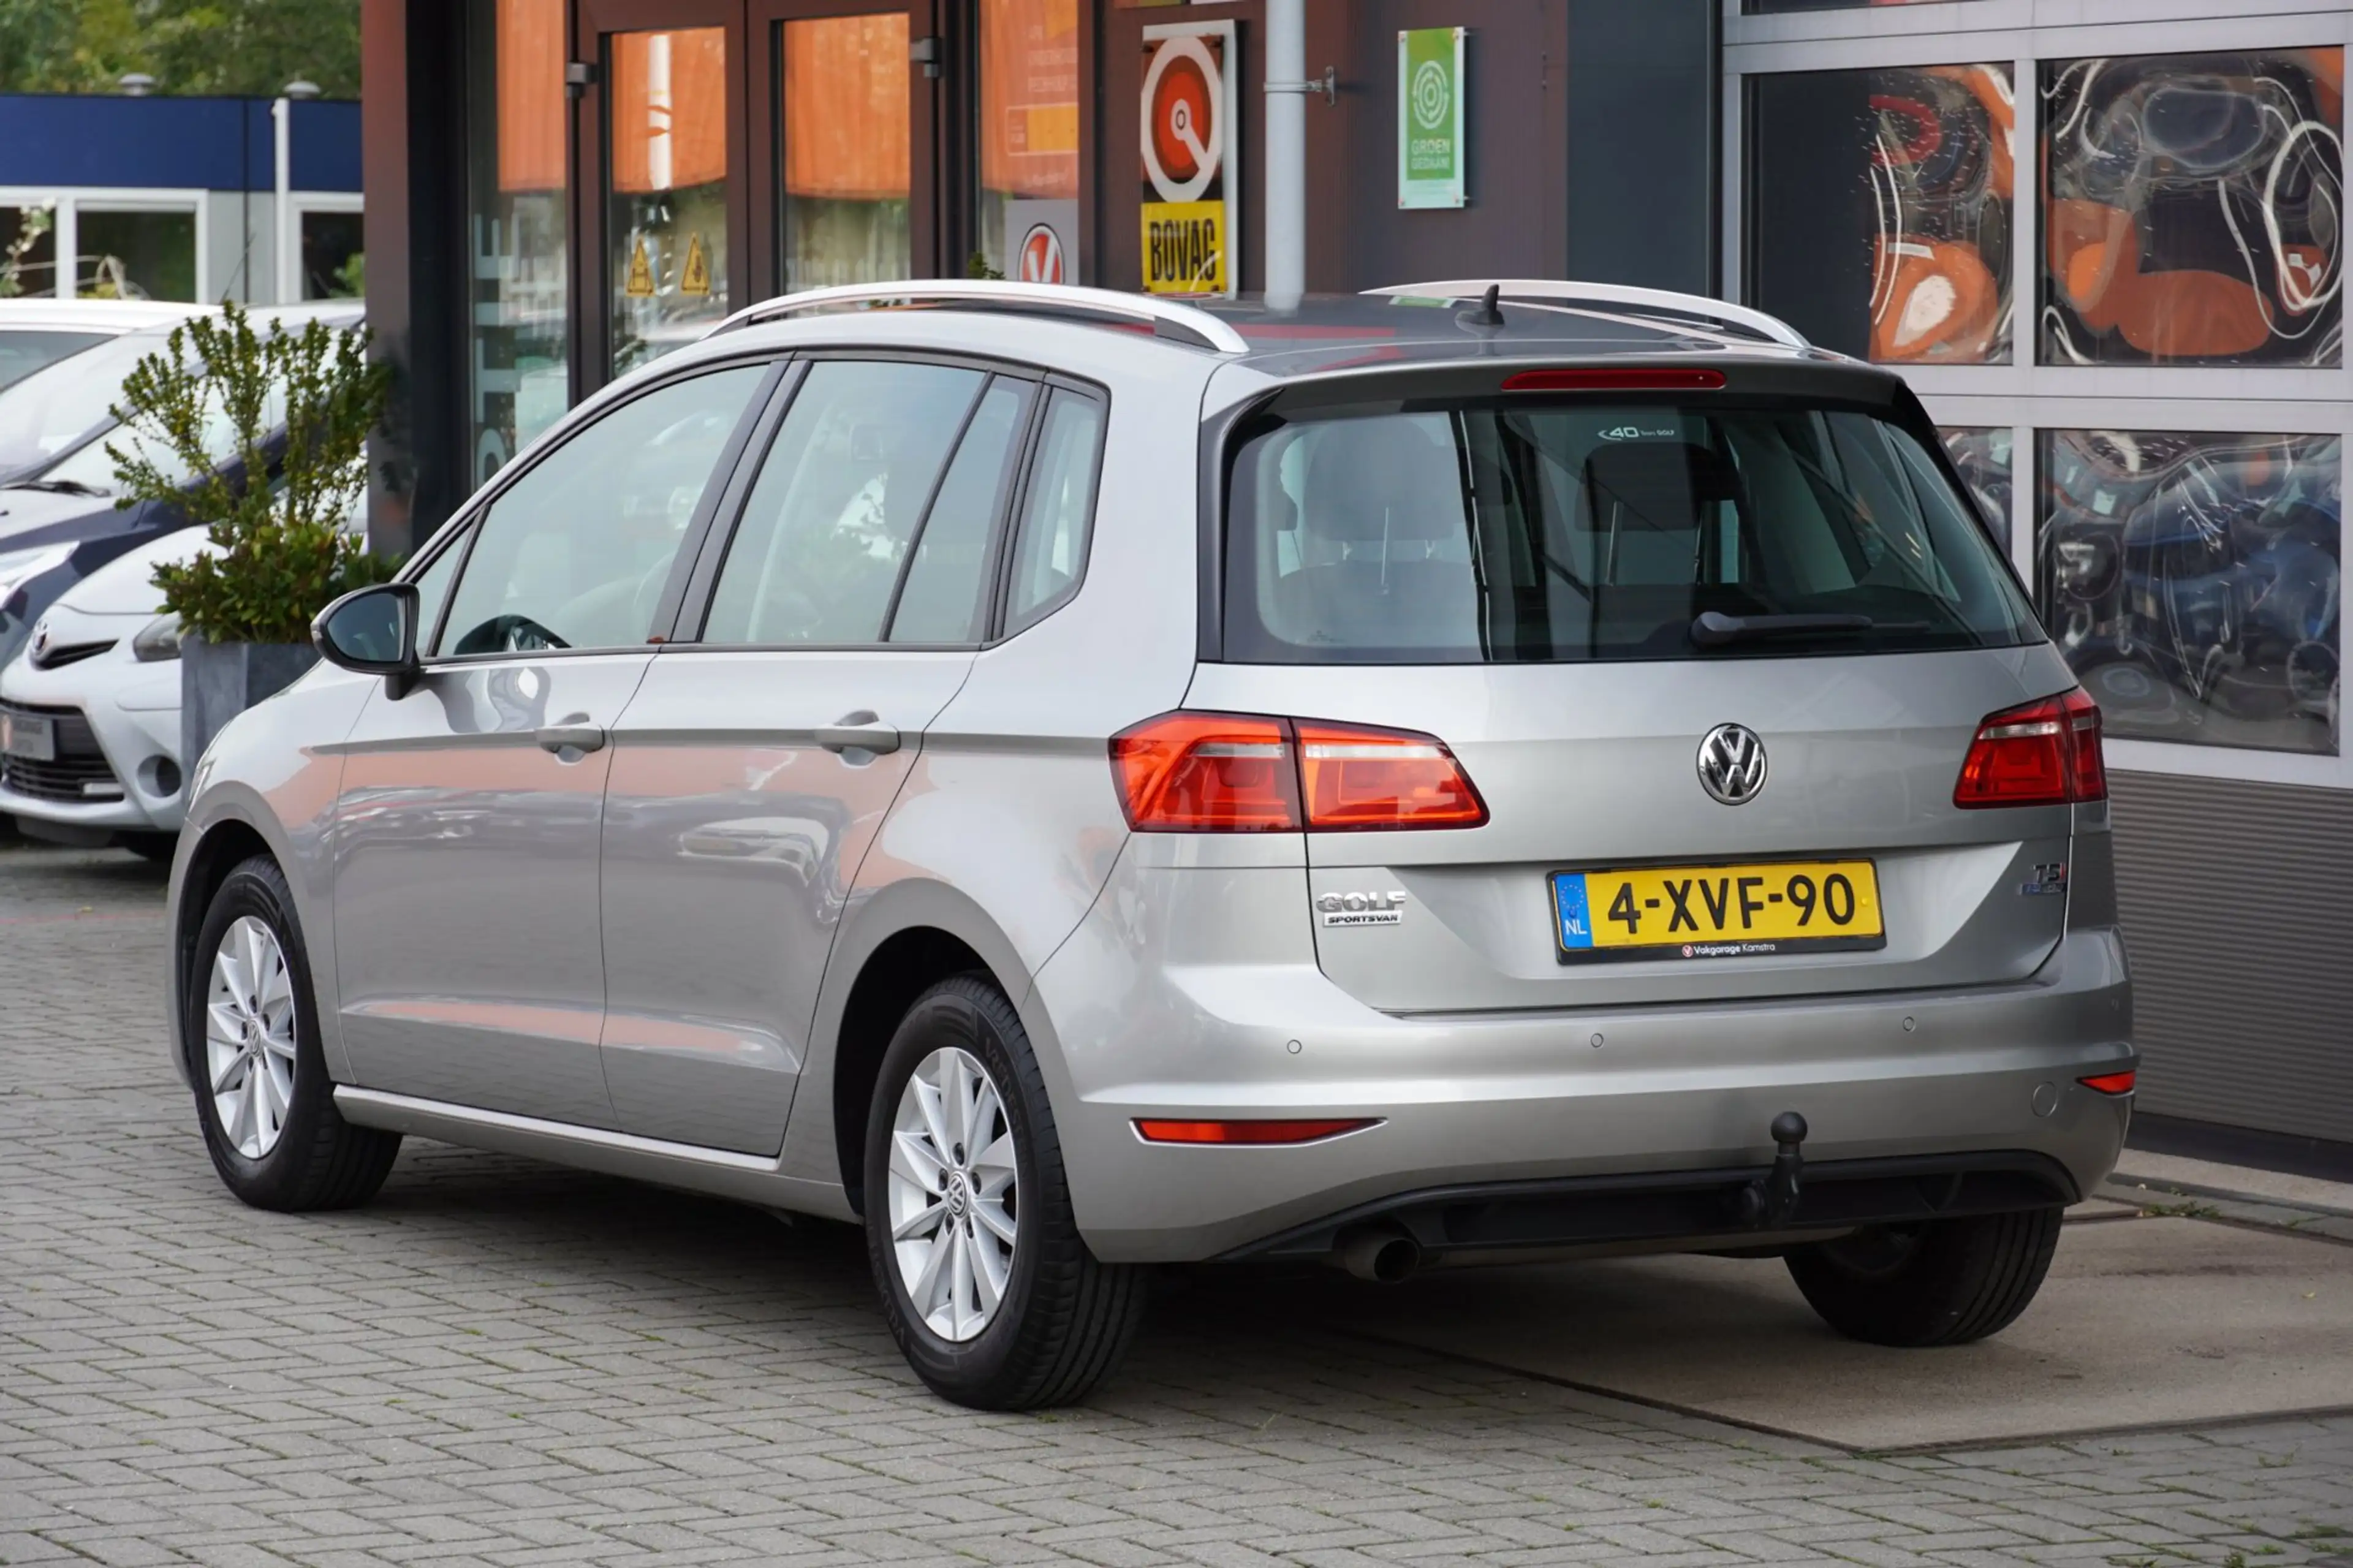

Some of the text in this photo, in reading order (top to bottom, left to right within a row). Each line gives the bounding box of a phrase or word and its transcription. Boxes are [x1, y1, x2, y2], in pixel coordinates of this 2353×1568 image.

[1411, 138, 1450, 154] GROEN
[1150, 218, 1216, 281] BOVAG
[1609, 427, 1639, 437] 40
[1316, 891, 1406, 913] GOLF
[1608, 873, 1855, 934] 4-XVF-90
[1328, 914, 1398, 923] SPORTSVAN
[1565, 919, 1588, 935] NL
[1694, 945, 1741, 956] Vakgarage
[1742, 943, 1776, 952] Kamstra
